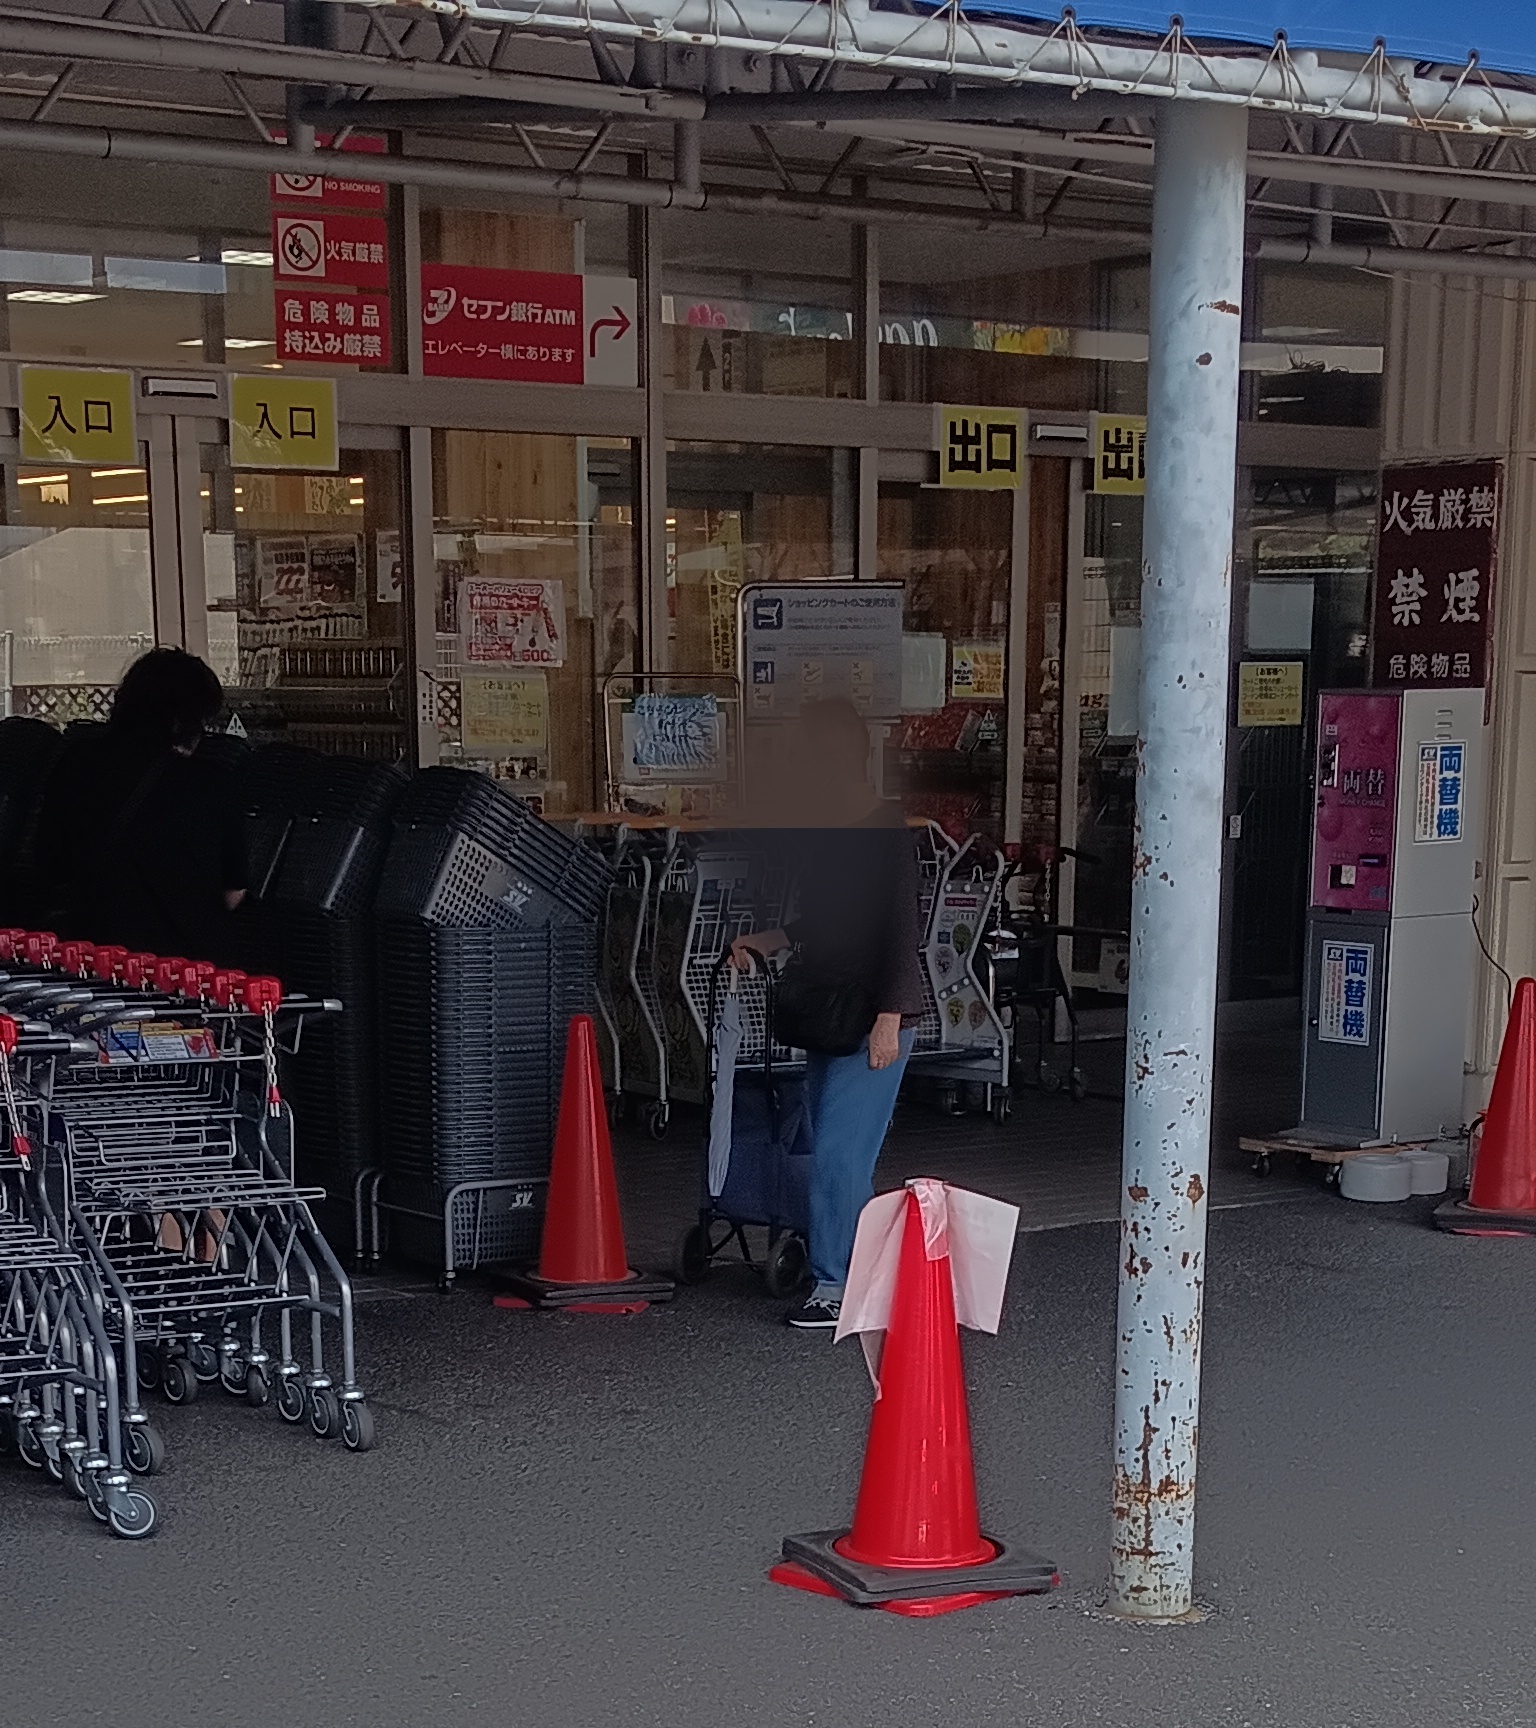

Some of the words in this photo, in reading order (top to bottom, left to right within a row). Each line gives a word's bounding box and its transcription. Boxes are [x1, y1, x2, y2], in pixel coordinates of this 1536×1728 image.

[324, 180, 338, 190] NO
[339, 182, 381, 194] SMOKING
[325, 240, 384, 264] 火気厳禁
[283, 299, 381, 328] 危険物品
[284, 329, 382, 358] 持込み厳禁
[424, 340, 576, 363] エレベーター横にあります
[41, 395, 114, 434] 入口
[256, 402, 318, 440] 入口
[948, 417, 1017, 474] 出口
[1382, 486, 1494, 536] 火気厳禁
[1388, 567, 1481, 627] 禁煙
[1388, 653, 1471, 679] 危険物品
[1343, 768, 1386, 796] 両替
[1437, 746, 1463, 838] 両替機
[1343, 948, 1368, 1038] 両替機
